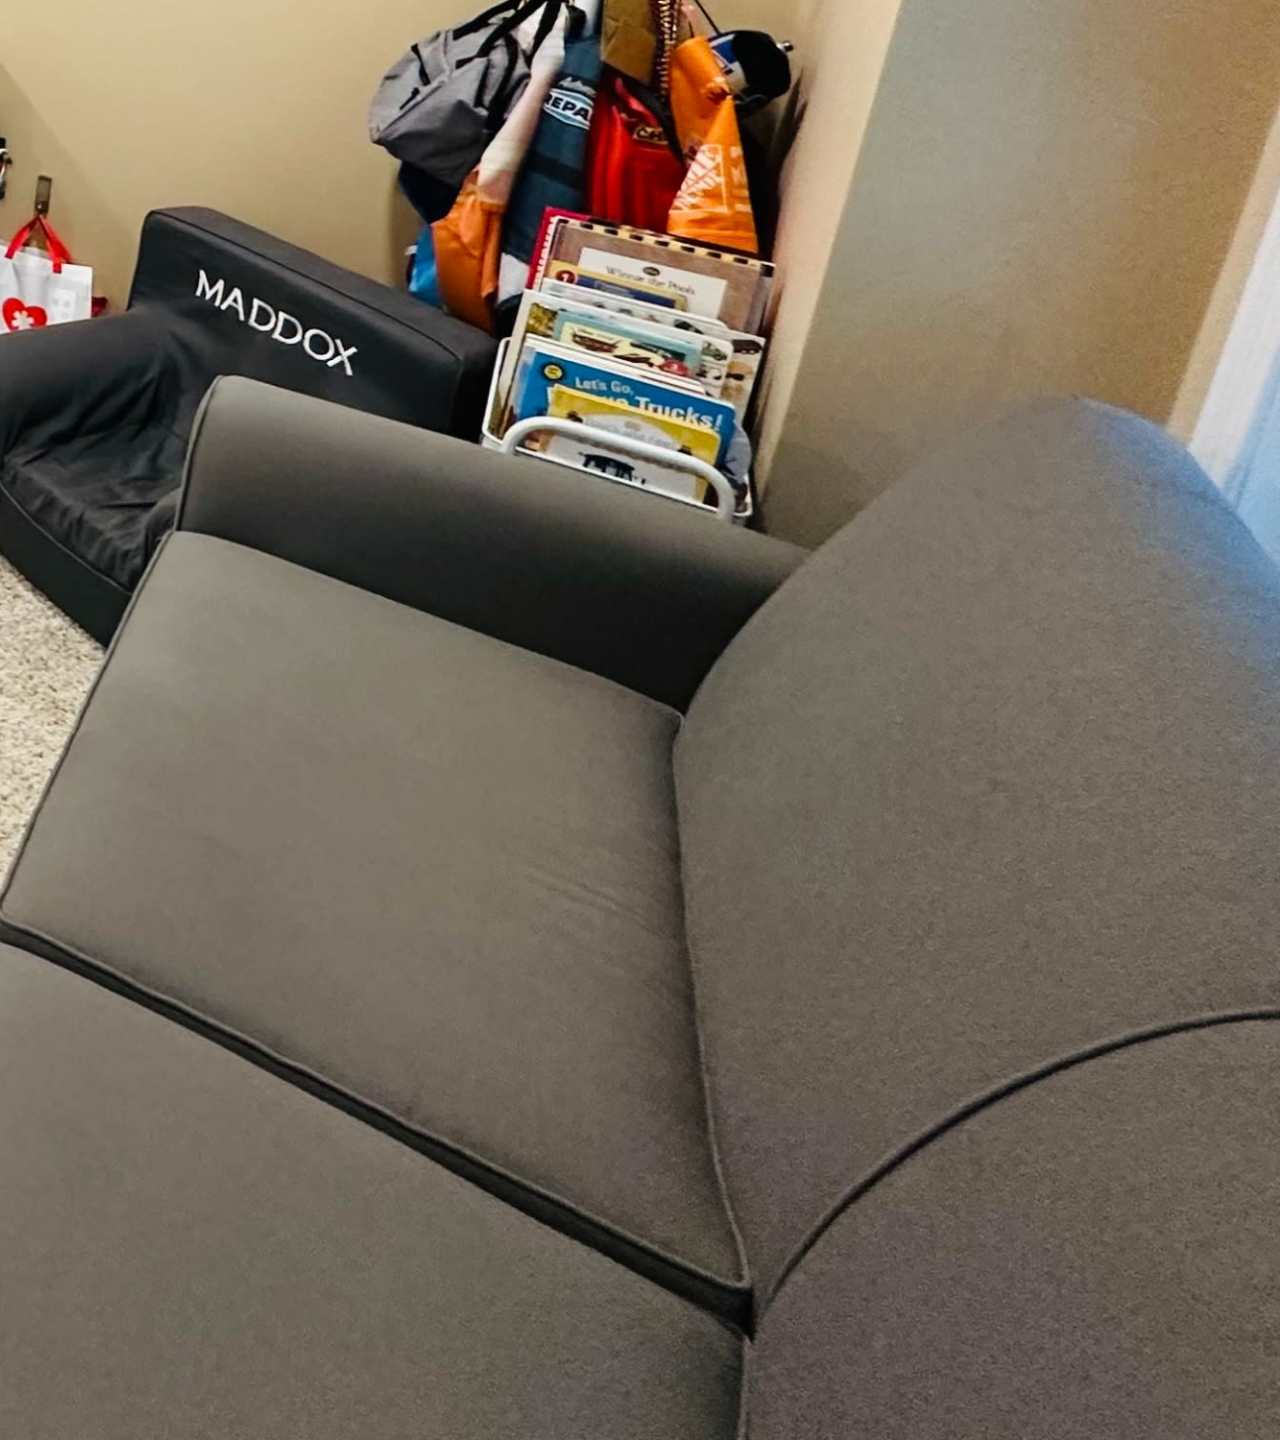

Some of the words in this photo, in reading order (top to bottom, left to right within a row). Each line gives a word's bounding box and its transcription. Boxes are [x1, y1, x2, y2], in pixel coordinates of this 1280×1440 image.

[195, 269, 358, 376] MADDOX
[575, 377, 608, 392] Let's
[634, 396, 723, 432] Trucks!
